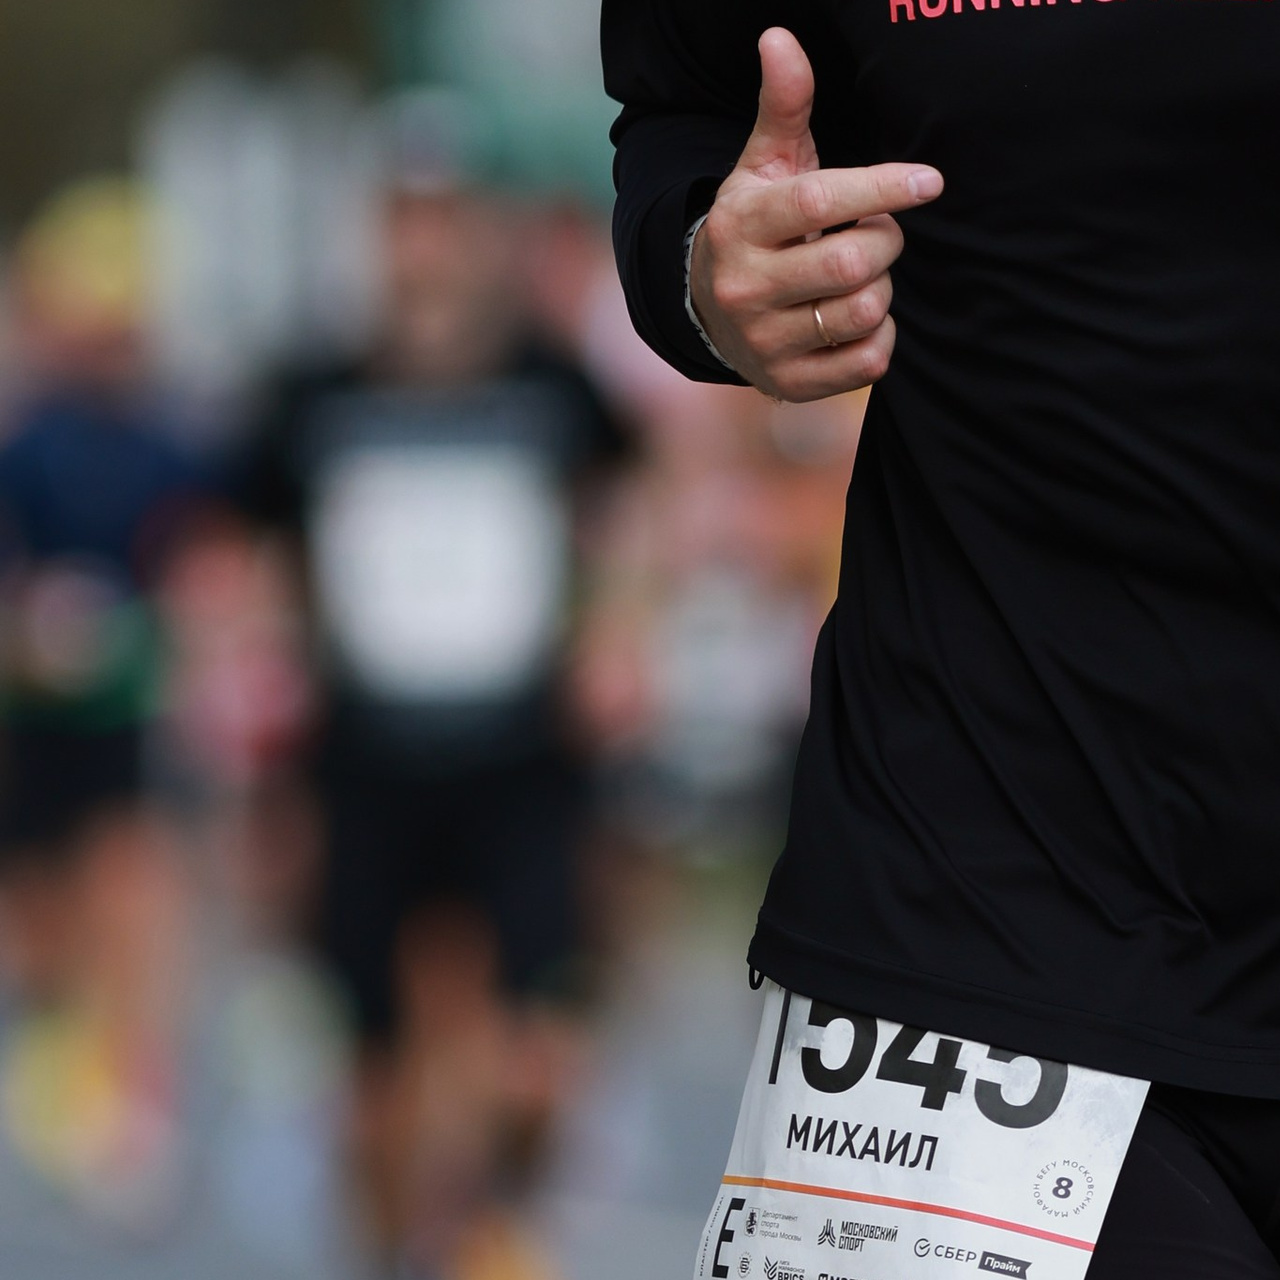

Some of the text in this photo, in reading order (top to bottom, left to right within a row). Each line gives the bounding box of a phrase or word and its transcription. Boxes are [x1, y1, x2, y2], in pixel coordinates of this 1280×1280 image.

[787, 1113, 938, 1171] МИХАИЛ
[1033, 1159, 1094, 1218] БЕГУ МОСКОВСКИЙ МАРАФОН
[1052, 1176, 1073, 1199] 8
[838, 1235, 866, 1252] СПОРТ
[840, 1221, 898, 1242] МОСКОВСКИЙ
[934, 1244, 1021, 1274] СБЕР Прайм
